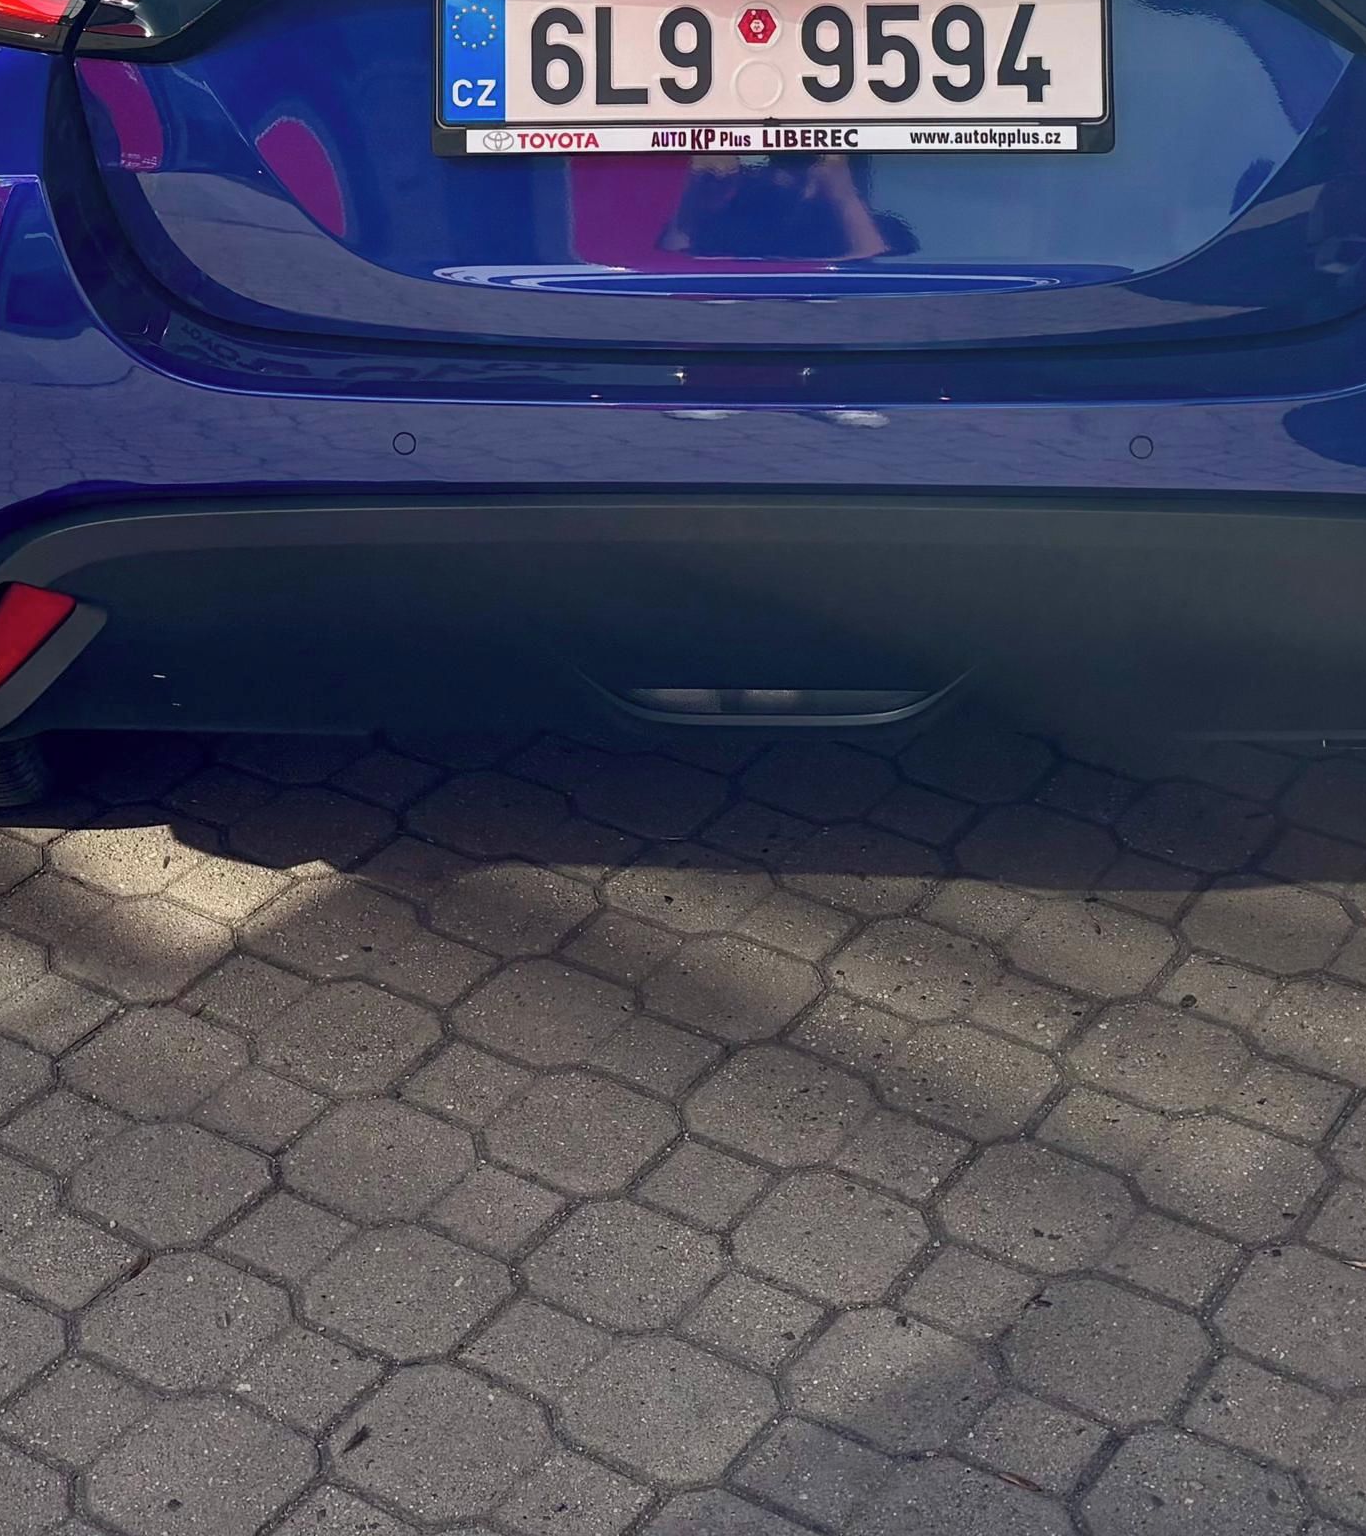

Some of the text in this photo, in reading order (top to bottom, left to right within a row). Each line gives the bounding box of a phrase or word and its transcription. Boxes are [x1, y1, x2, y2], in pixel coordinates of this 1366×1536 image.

[531, 4, 1051, 105] 6L9 9594
[452, 79, 497, 107] CZ
[517, 128, 1062, 150] TOYOTA AUTO KP Plus LIBEREC www.autokpplus.cz
